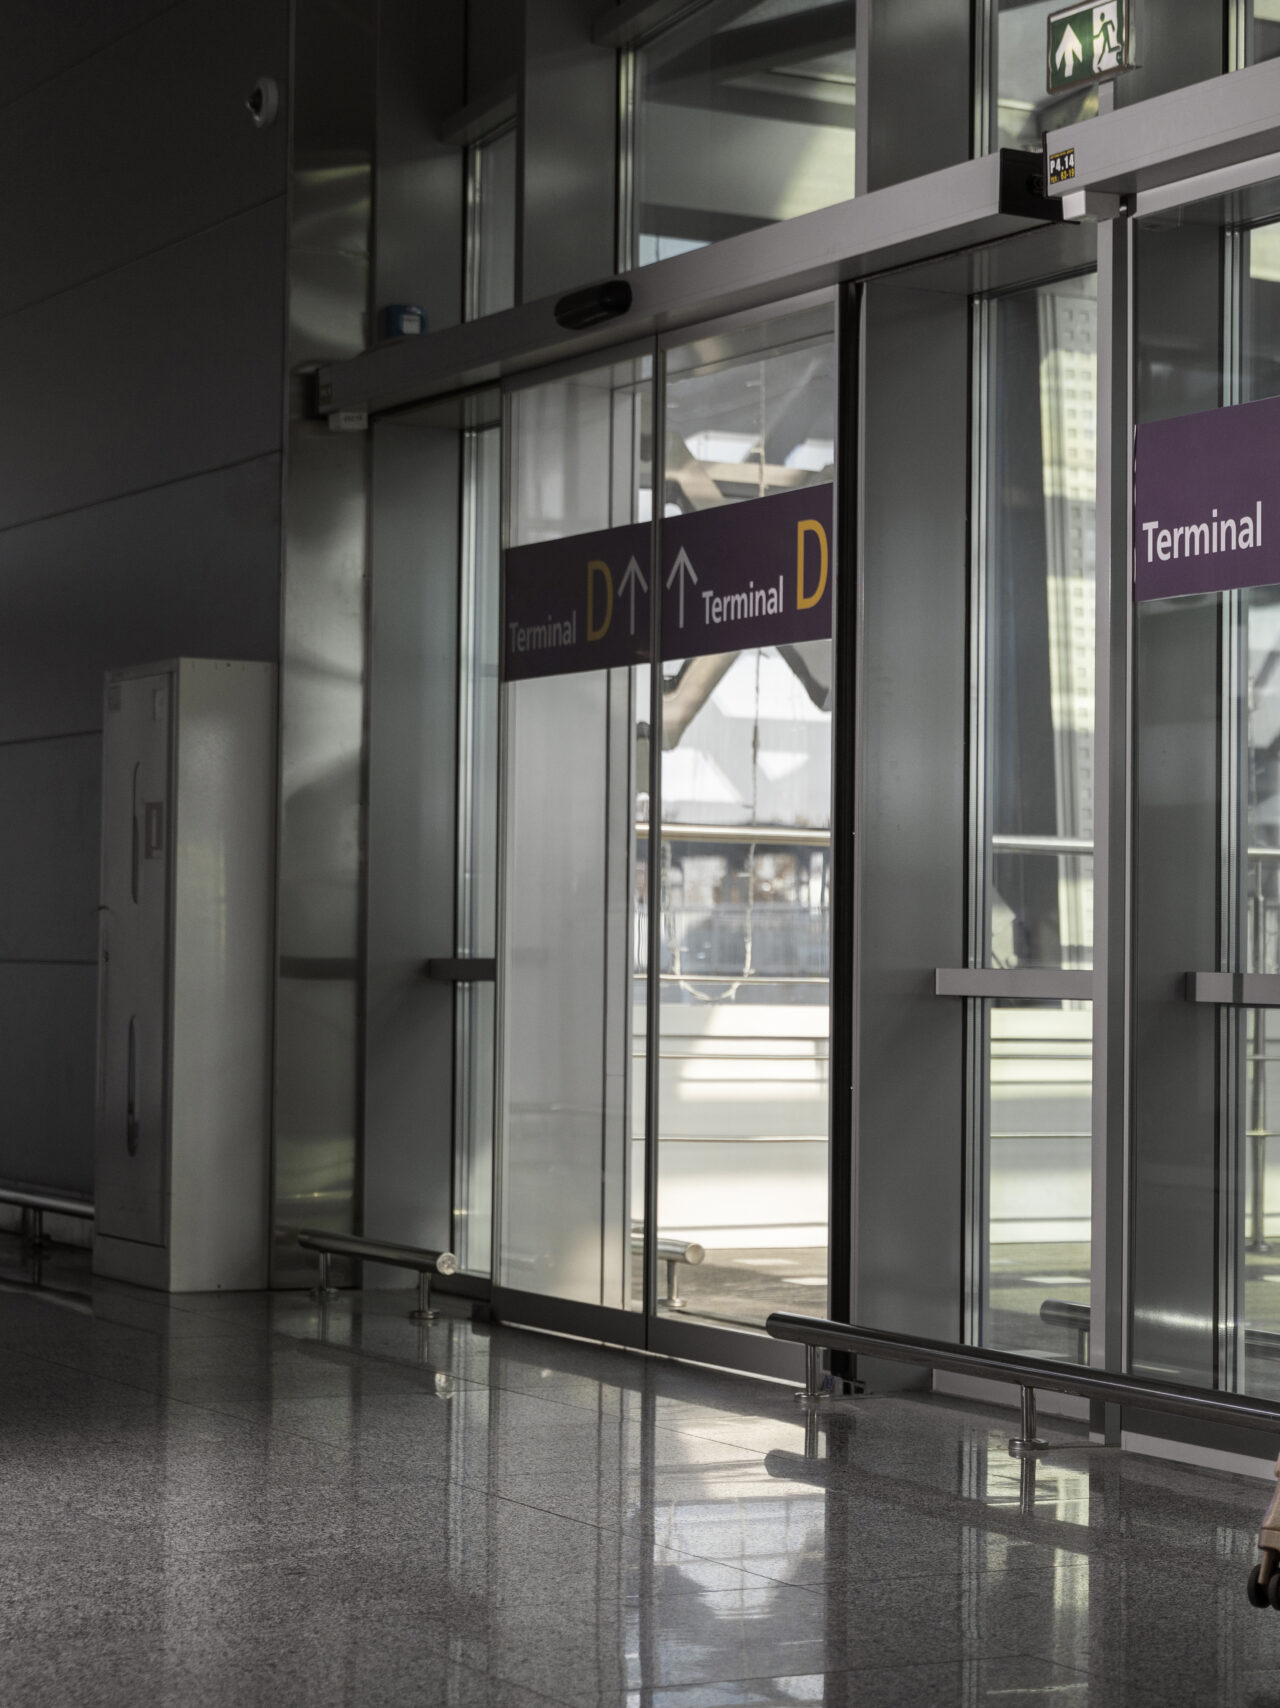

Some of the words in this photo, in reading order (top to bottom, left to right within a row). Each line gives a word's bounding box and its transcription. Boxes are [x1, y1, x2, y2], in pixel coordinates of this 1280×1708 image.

[1050, 153, 1075, 174] P4.14
[1142, 501, 1262, 563] Terminal
[509, 610, 577, 653] Terminal
[586, 560, 614, 642] D
[702, 575, 784, 625] Terminal
[796, 519, 829, 610] D
